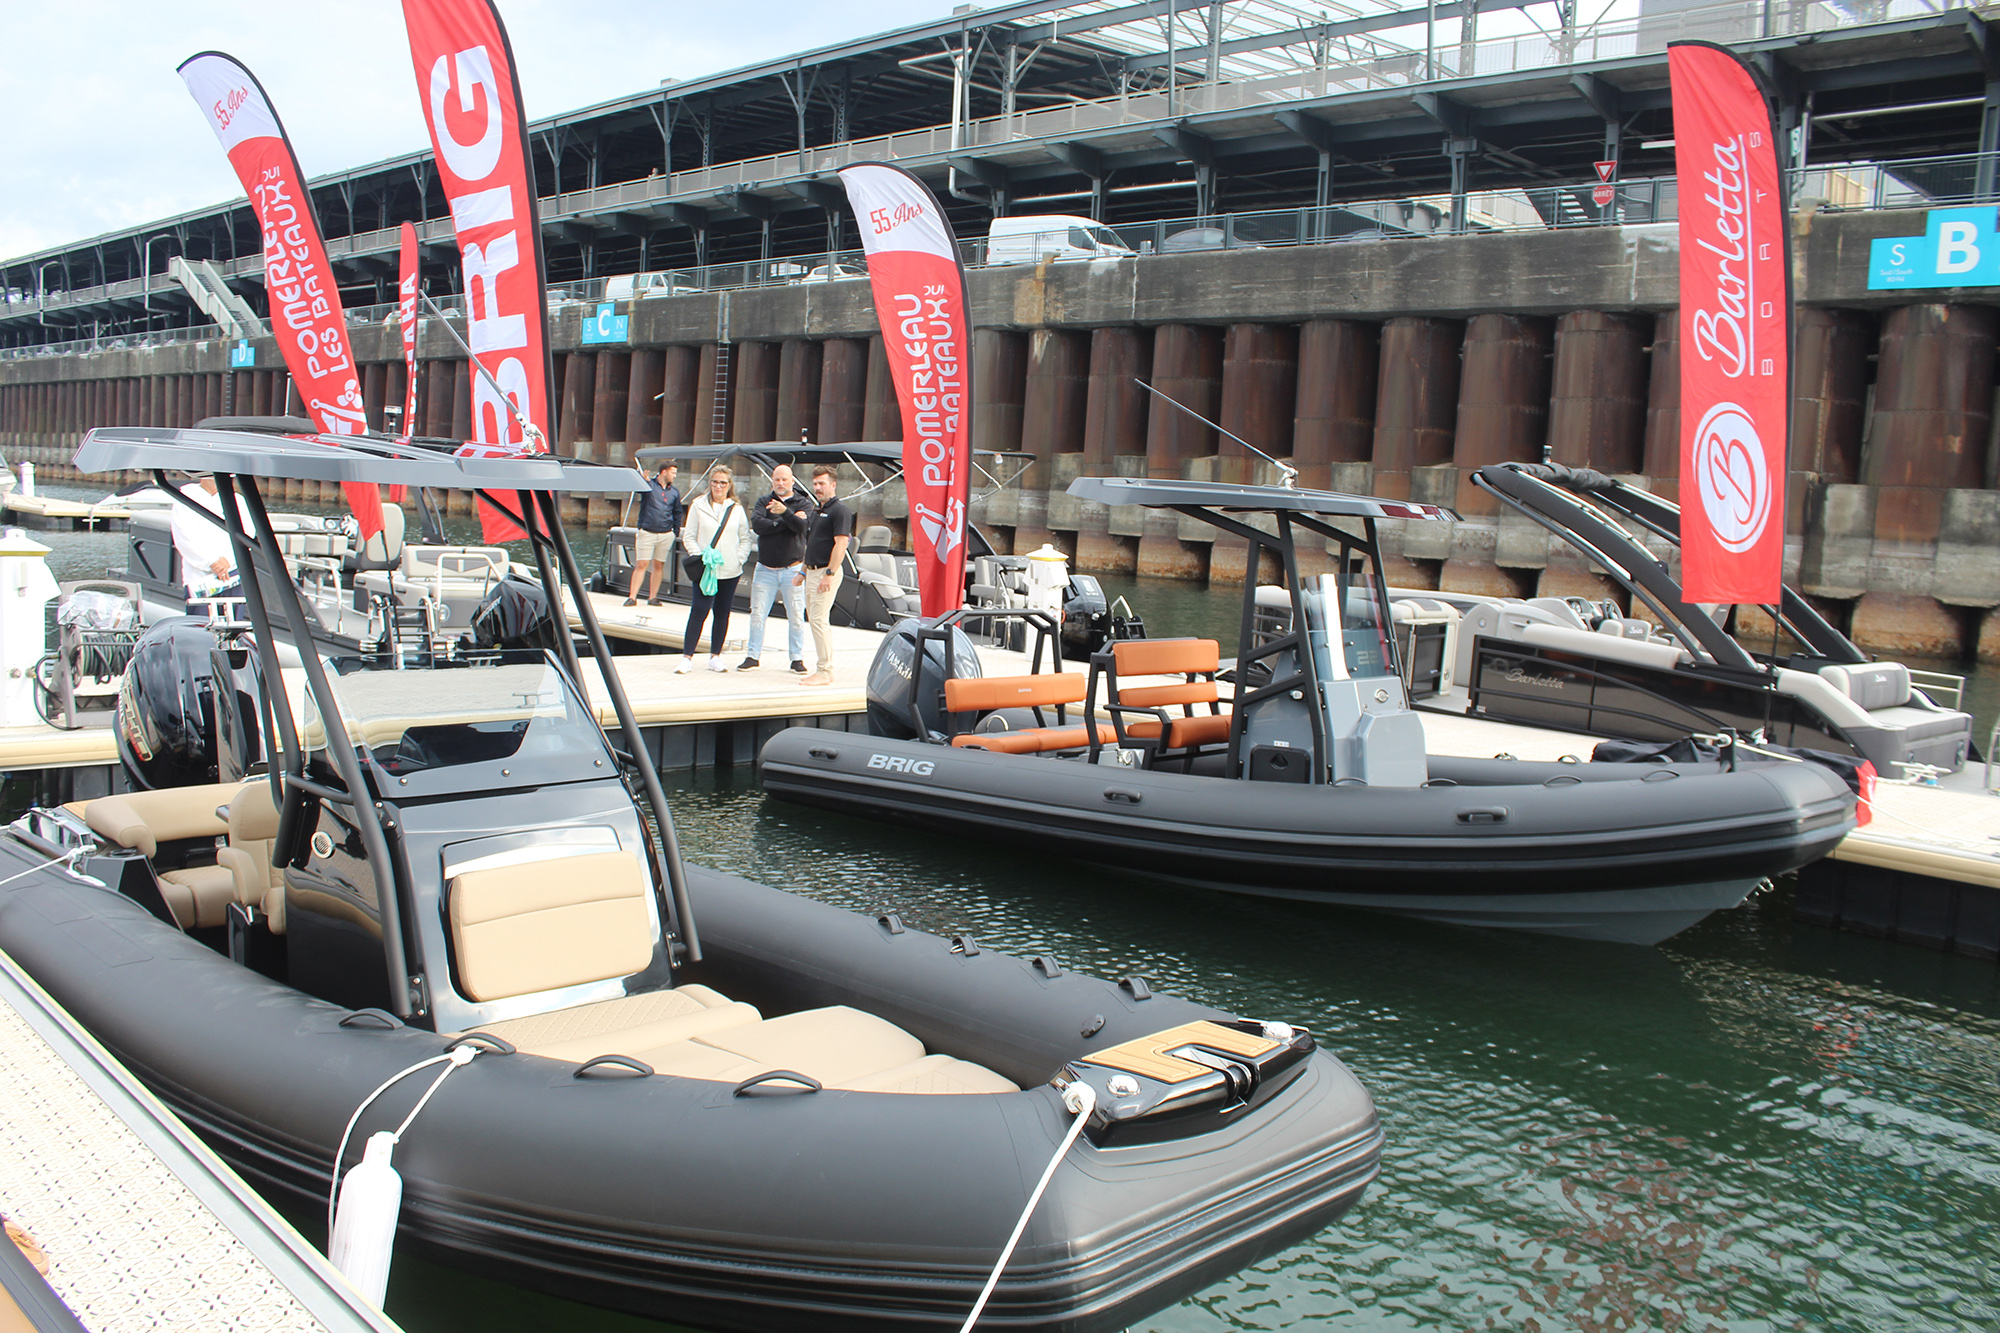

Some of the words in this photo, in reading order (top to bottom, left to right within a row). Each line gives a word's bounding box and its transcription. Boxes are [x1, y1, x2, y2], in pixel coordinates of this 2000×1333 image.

[213, 100, 230, 131] 55
[228, 85, 249, 120] Ans
[870, 207, 892, 235] 55
[892, 202, 924, 229] Ans
[265, 180, 331, 318] BATEAUX
[430, 45, 530, 457] BRIG
[1693, 136, 1746, 378] Barletta
[1750, 131, 1774, 376] BOATS
[1890, 244, 1906, 266] S
[1936, 221, 1981, 274] B
[586, 320, 592, 332] S
[598, 309, 610, 337] C
[616, 318, 624, 329] N
[239, 343, 246, 362] D
[321, 327, 349, 373] LES
[894, 294, 948, 487] POMERLEAU
[887, 648, 913, 680] YAMAHA
[1505, 667, 1565, 689] Barletta
[867, 754, 935, 776] BRIG
